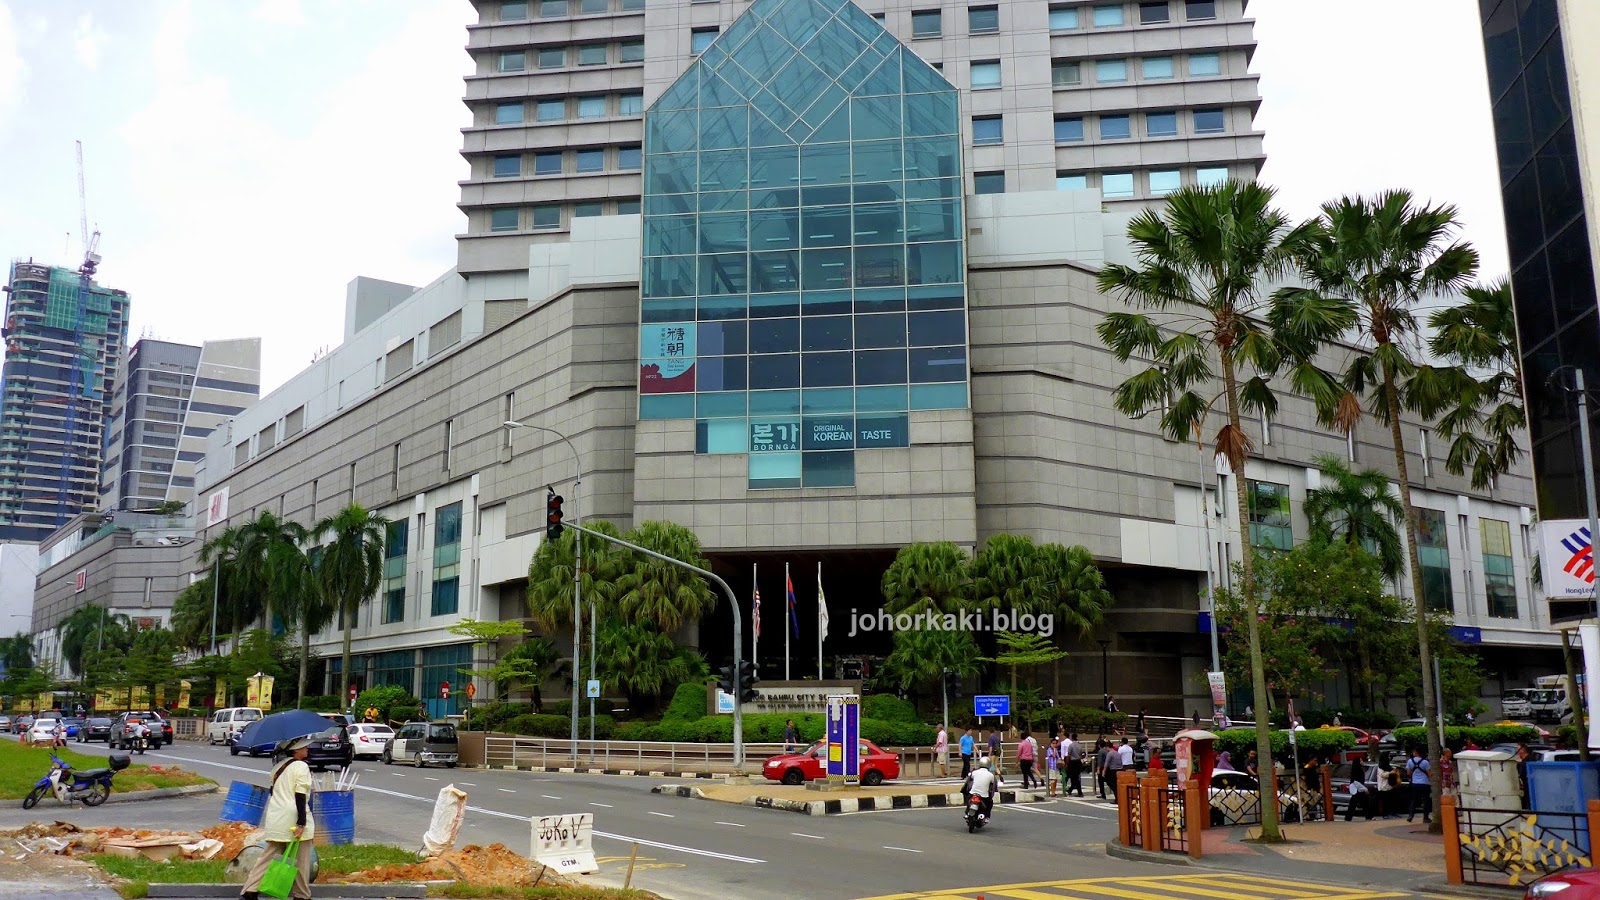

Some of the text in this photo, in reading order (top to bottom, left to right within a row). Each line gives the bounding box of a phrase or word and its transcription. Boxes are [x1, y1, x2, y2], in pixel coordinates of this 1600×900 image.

[752, 423, 799, 443] 본가
[813, 424, 845, 432] ORIGINAL
[813, 430, 892, 442] KOREAN TASTE
[753, 443, 797, 451] BORNGA
